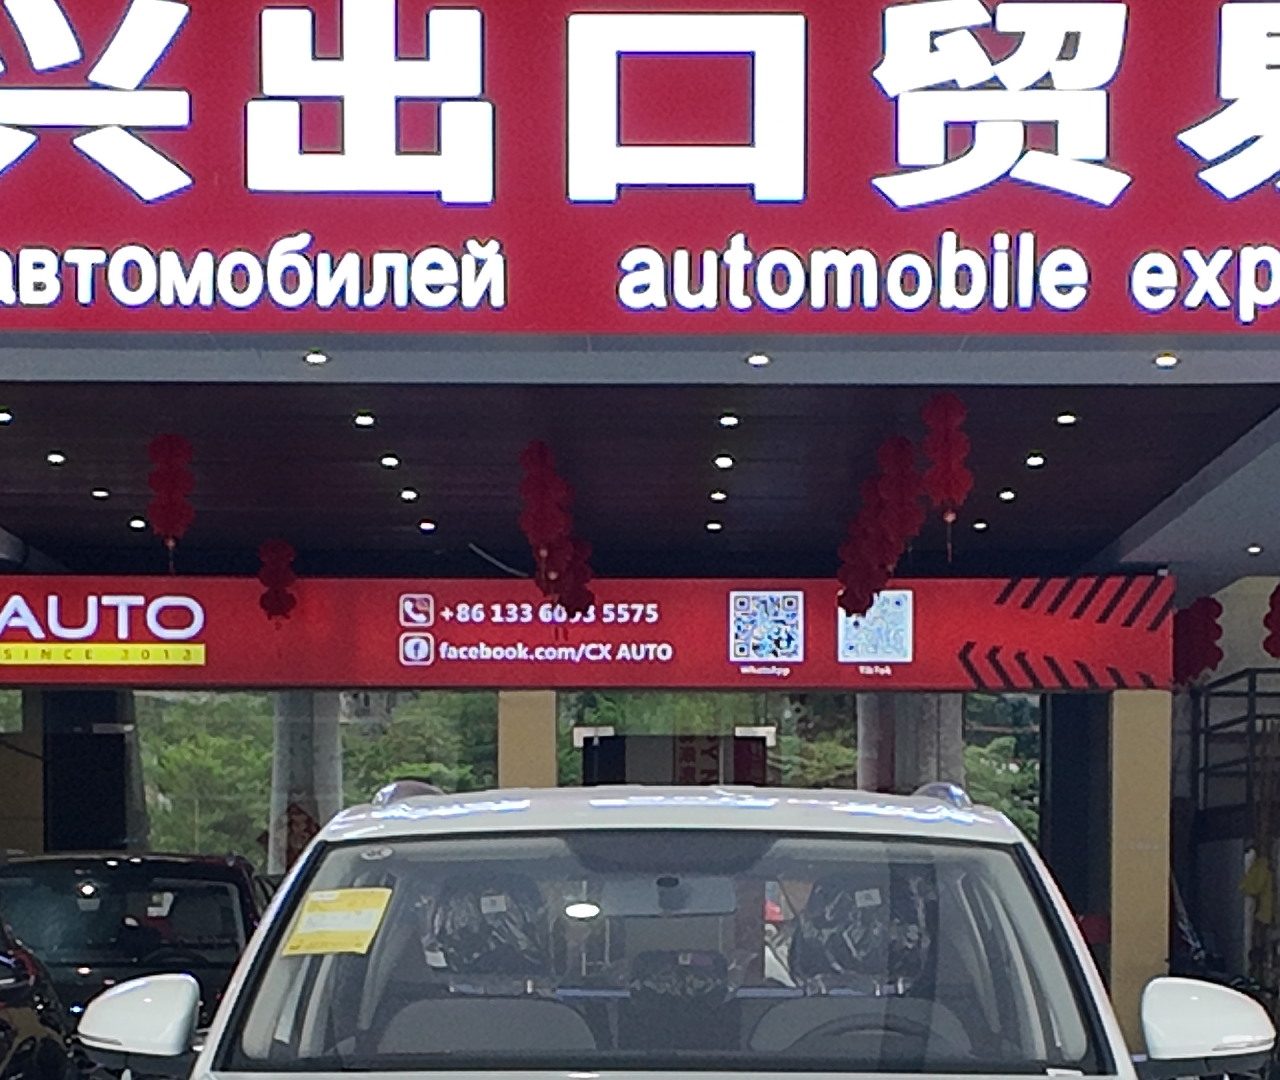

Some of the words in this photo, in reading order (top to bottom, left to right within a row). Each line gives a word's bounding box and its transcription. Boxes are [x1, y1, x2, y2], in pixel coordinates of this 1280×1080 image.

[617, 231, 1090, 310] automobile
[440, 603, 485, 622] +86
[491, 604, 533, 622] 133
[602, 604, 658, 622] 5575
[3, 649, 94, 660] SINCE
[439, 642, 612, 662] facebook.com/CX
[616, 644, 673, 660] AUTO
